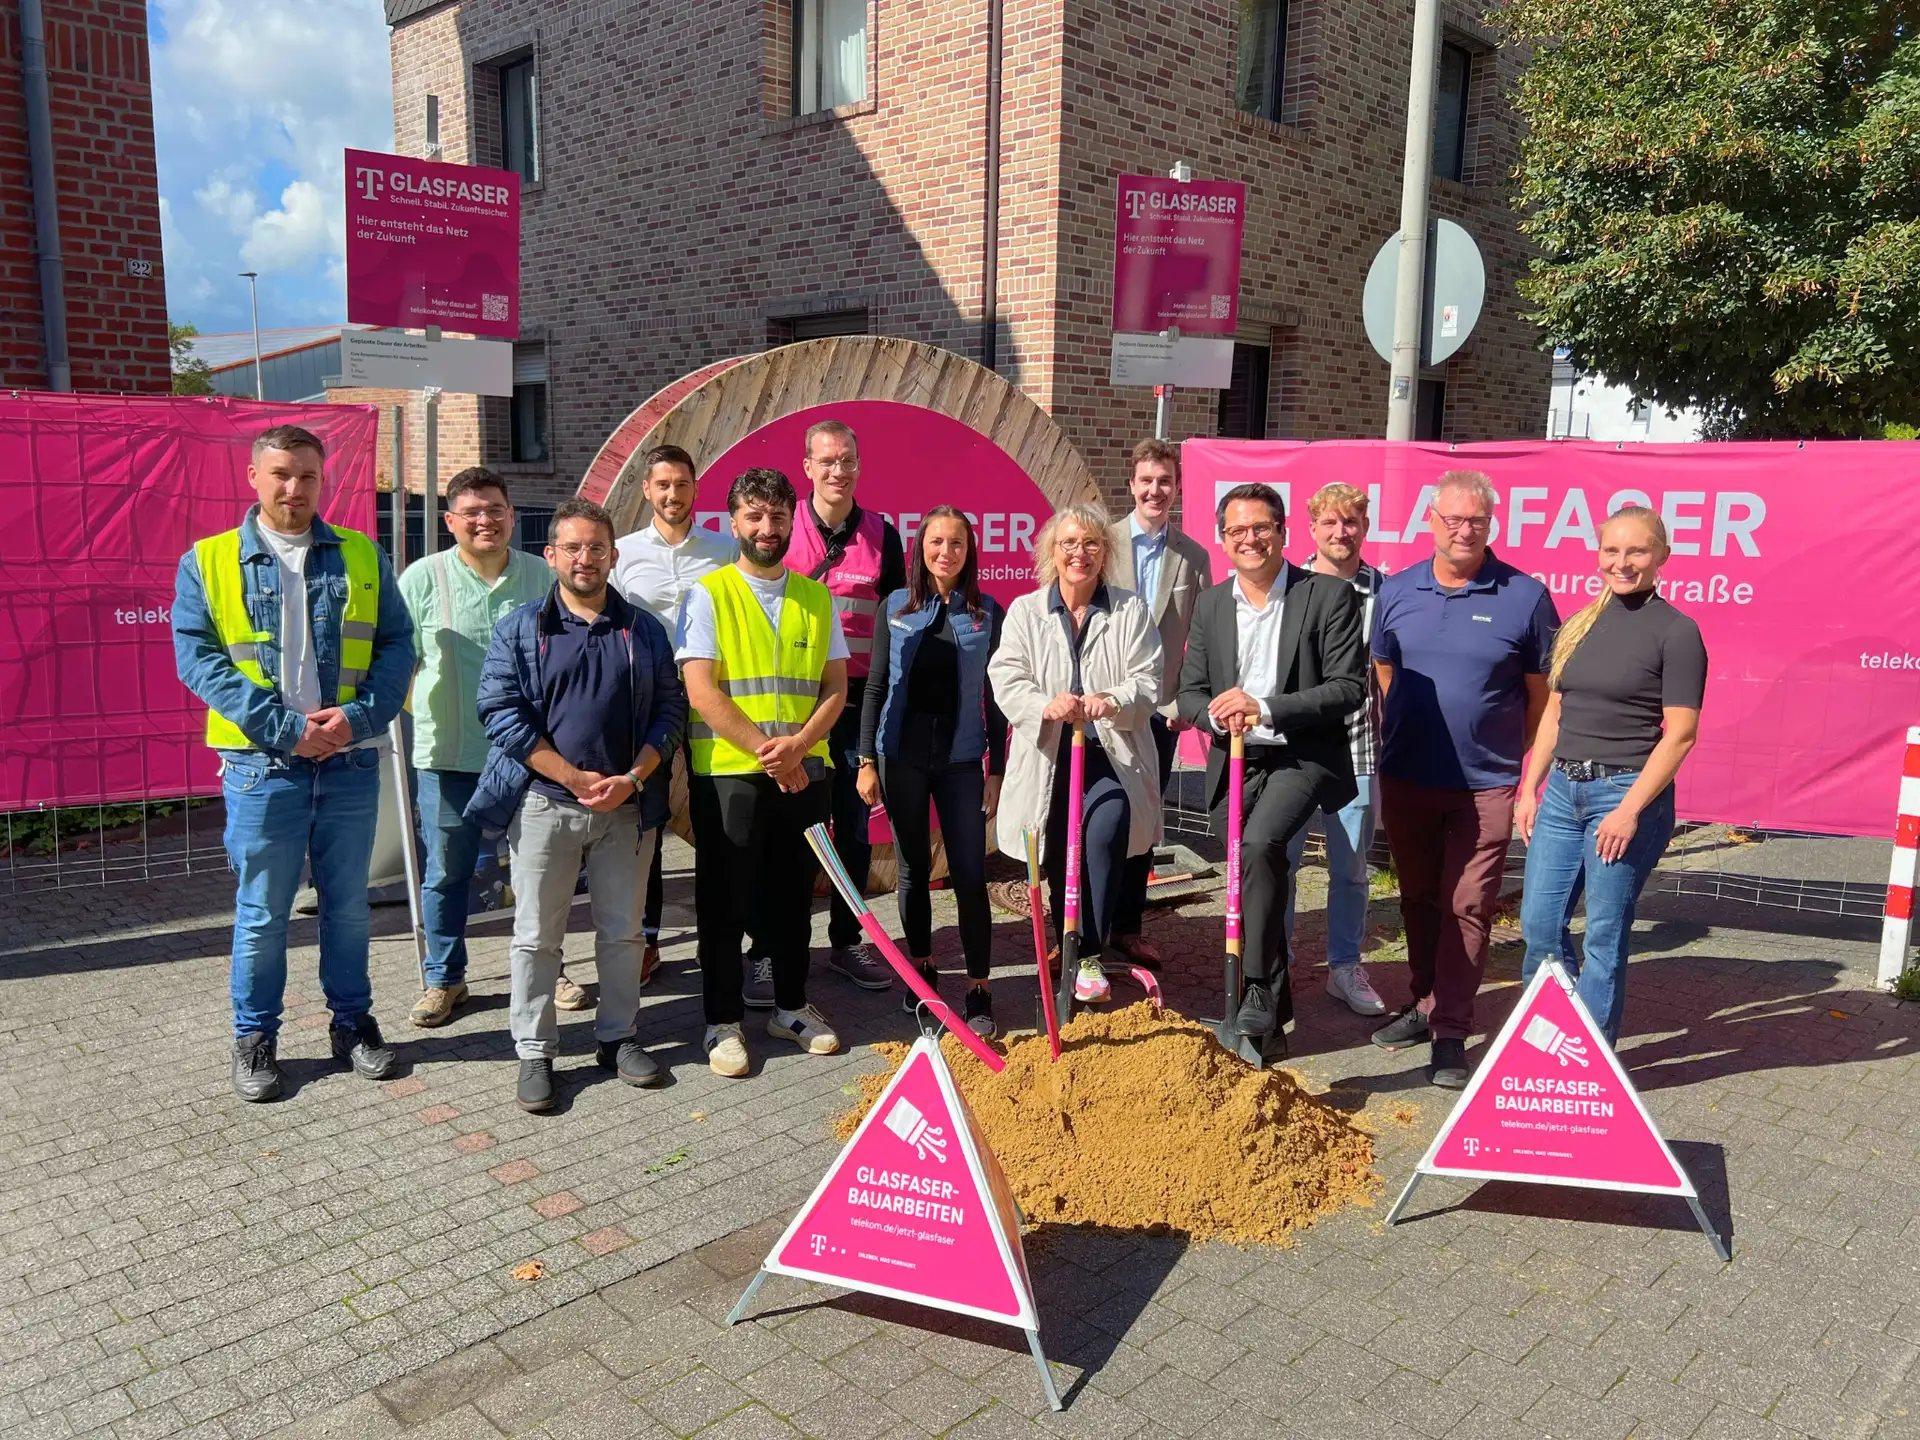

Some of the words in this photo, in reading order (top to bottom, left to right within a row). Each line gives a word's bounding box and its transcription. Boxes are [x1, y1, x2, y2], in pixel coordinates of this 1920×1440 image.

[390, 172, 509, 205] GLASFASER
[390, 195, 422, 207] Schnell.
[424, 200, 449, 211] Stabil.
[451, 204, 509, 218] Zukunftssicher.
[1149, 192, 1236, 214] GLASFASER
[357, 214, 378, 226] Hier
[380, 220, 424, 232] entsteht
[426, 223, 443, 234] das
[446, 226, 469, 238] Netz
[357, 229, 375, 239] der
[376, 231, 416, 245] Zukunft
[1123, 232, 1139, 242] Hier
[1140, 235, 1172, 244] entsteht
[1173, 236, 1187, 245] das
[1188, 236, 1205, 246] Netz
[1123, 245, 1136, 254] der
[1136, 245, 1166, 256] Zukunft
[132, 261, 151, 276] 22
[410, 306, 479, 320] telekom.de/glasfaser
[431, 298, 449, 307] Mehr
[449, 300, 465, 309] dazu
[1654, 574, 1754, 605] traße
[114, 605, 171, 625] telek
[1501, 1076, 1607, 1097] GLASFASER-
[1495, 1095, 1614, 1118] BAUARBEITEN
[1501, 1120, 1608, 1136] telekom.de/jetzt-glasfaser
[856, 1166, 960, 1199] GLASFASER-
[848, 1187, 964, 1226] BAUARBEITEN
[850, 1216, 955, 1246] telekom.de/jetzt-glasfaser
